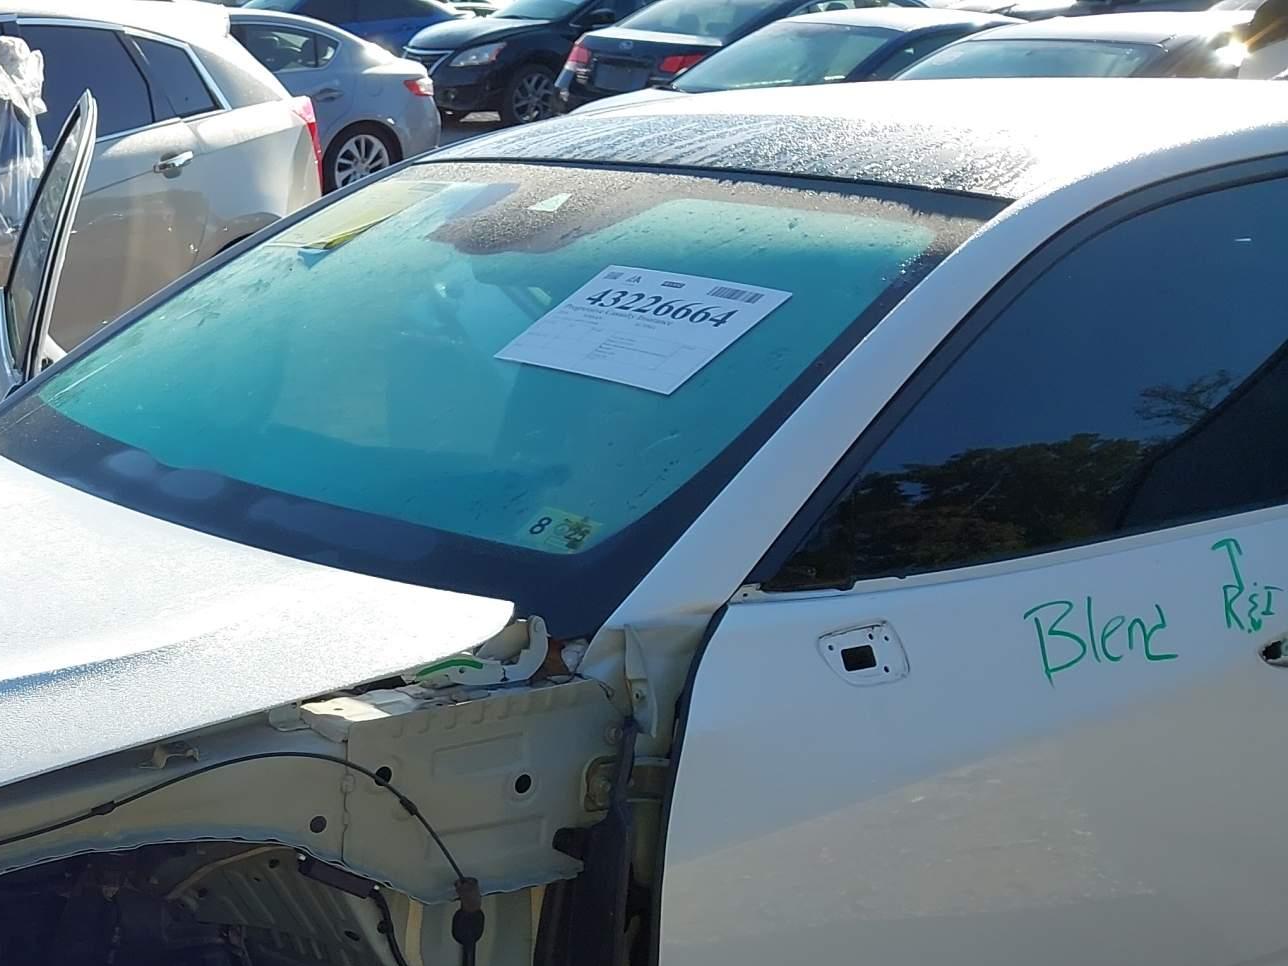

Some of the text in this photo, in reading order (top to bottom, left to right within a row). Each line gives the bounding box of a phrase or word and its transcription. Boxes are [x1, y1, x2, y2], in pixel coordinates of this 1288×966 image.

[585, 288, 739, 328] 43226664
[529, 516, 552, 535] 8
[1023, 595, 1179, 688] Blend
